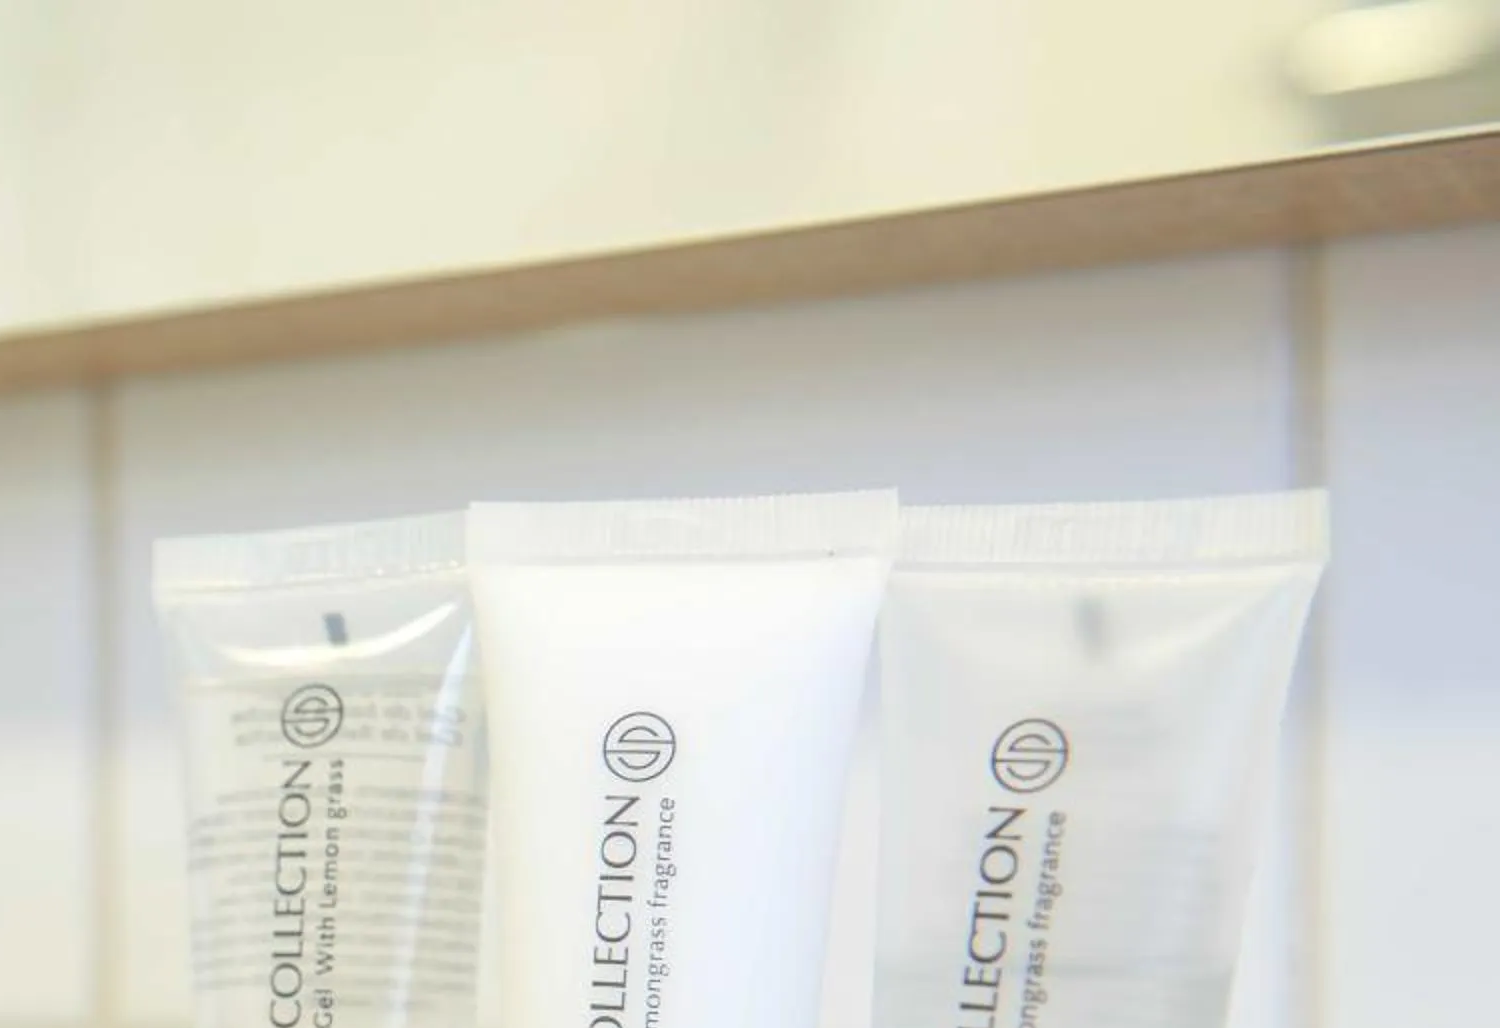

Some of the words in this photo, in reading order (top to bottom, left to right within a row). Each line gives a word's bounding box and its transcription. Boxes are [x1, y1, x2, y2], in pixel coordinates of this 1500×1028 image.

[326, 758, 348, 821] grass
[318, 826, 340, 909] Lemon
[646, 796, 677, 909] fragrance
[1025, 810, 1067, 932] fragrance
[315, 915, 336, 975] With
